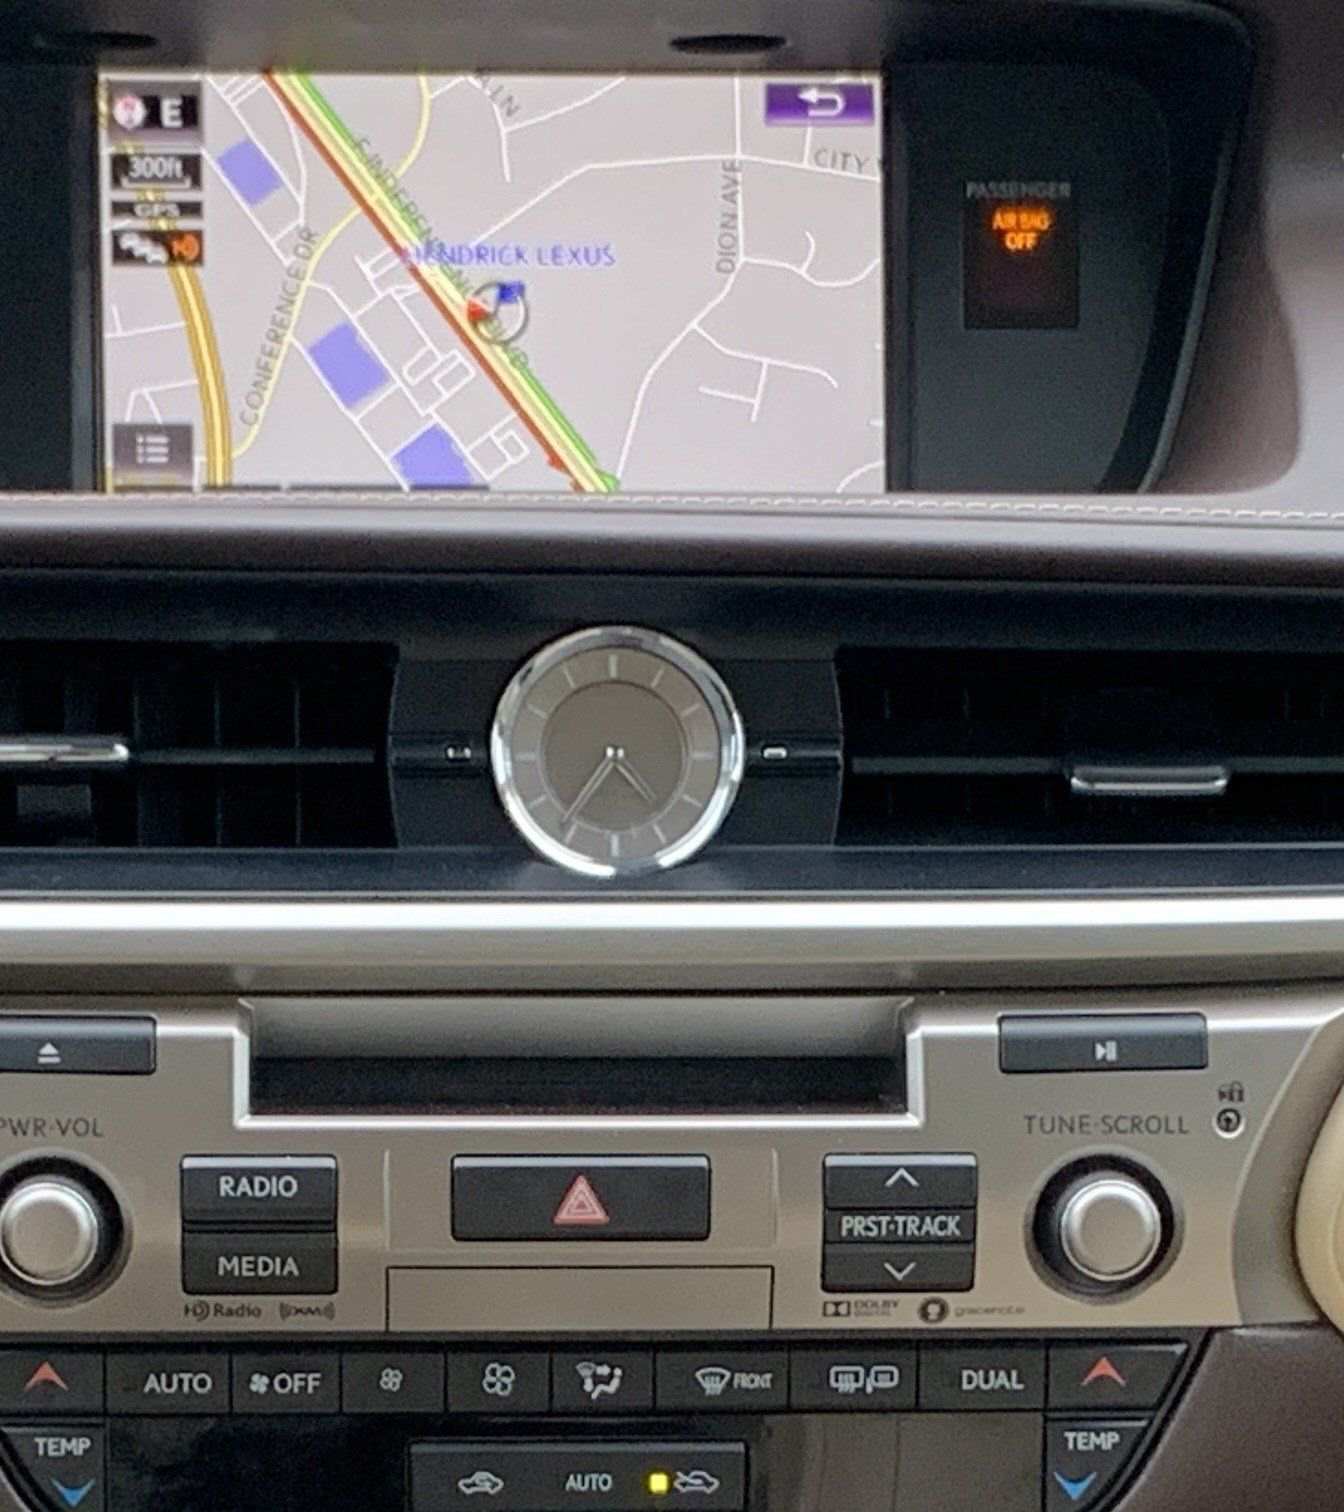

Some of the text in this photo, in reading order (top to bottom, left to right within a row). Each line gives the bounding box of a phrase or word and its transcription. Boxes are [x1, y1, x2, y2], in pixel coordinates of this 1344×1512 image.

[161, 98, 183, 127] E
[129, 156, 183, 179] 300ft
[814, 148, 869, 174] CITY
[721, 159, 743, 206] AVE
[1005, 231, 1038, 252] OFF
[537, 243, 617, 266] LEXUS
[240, 265, 308, 428] CONFERENCE
[219, 1175, 299, 1198] RADIO
[217, 1255, 300, 1277] MEDIA
[212, 1302, 262, 1318] Radio
[143, 1372, 213, 1394] AUTO
[273, 1372, 322, 1394] OFF
[733, 1372, 773, 1389] FRONT
[961, 1370, 1025, 1390] DUAL
[34, 1436, 91, 1456] TEMP
[1064, 1432, 1121, 1451] TEMP
[565, 1474, 613, 1492] AUTO
